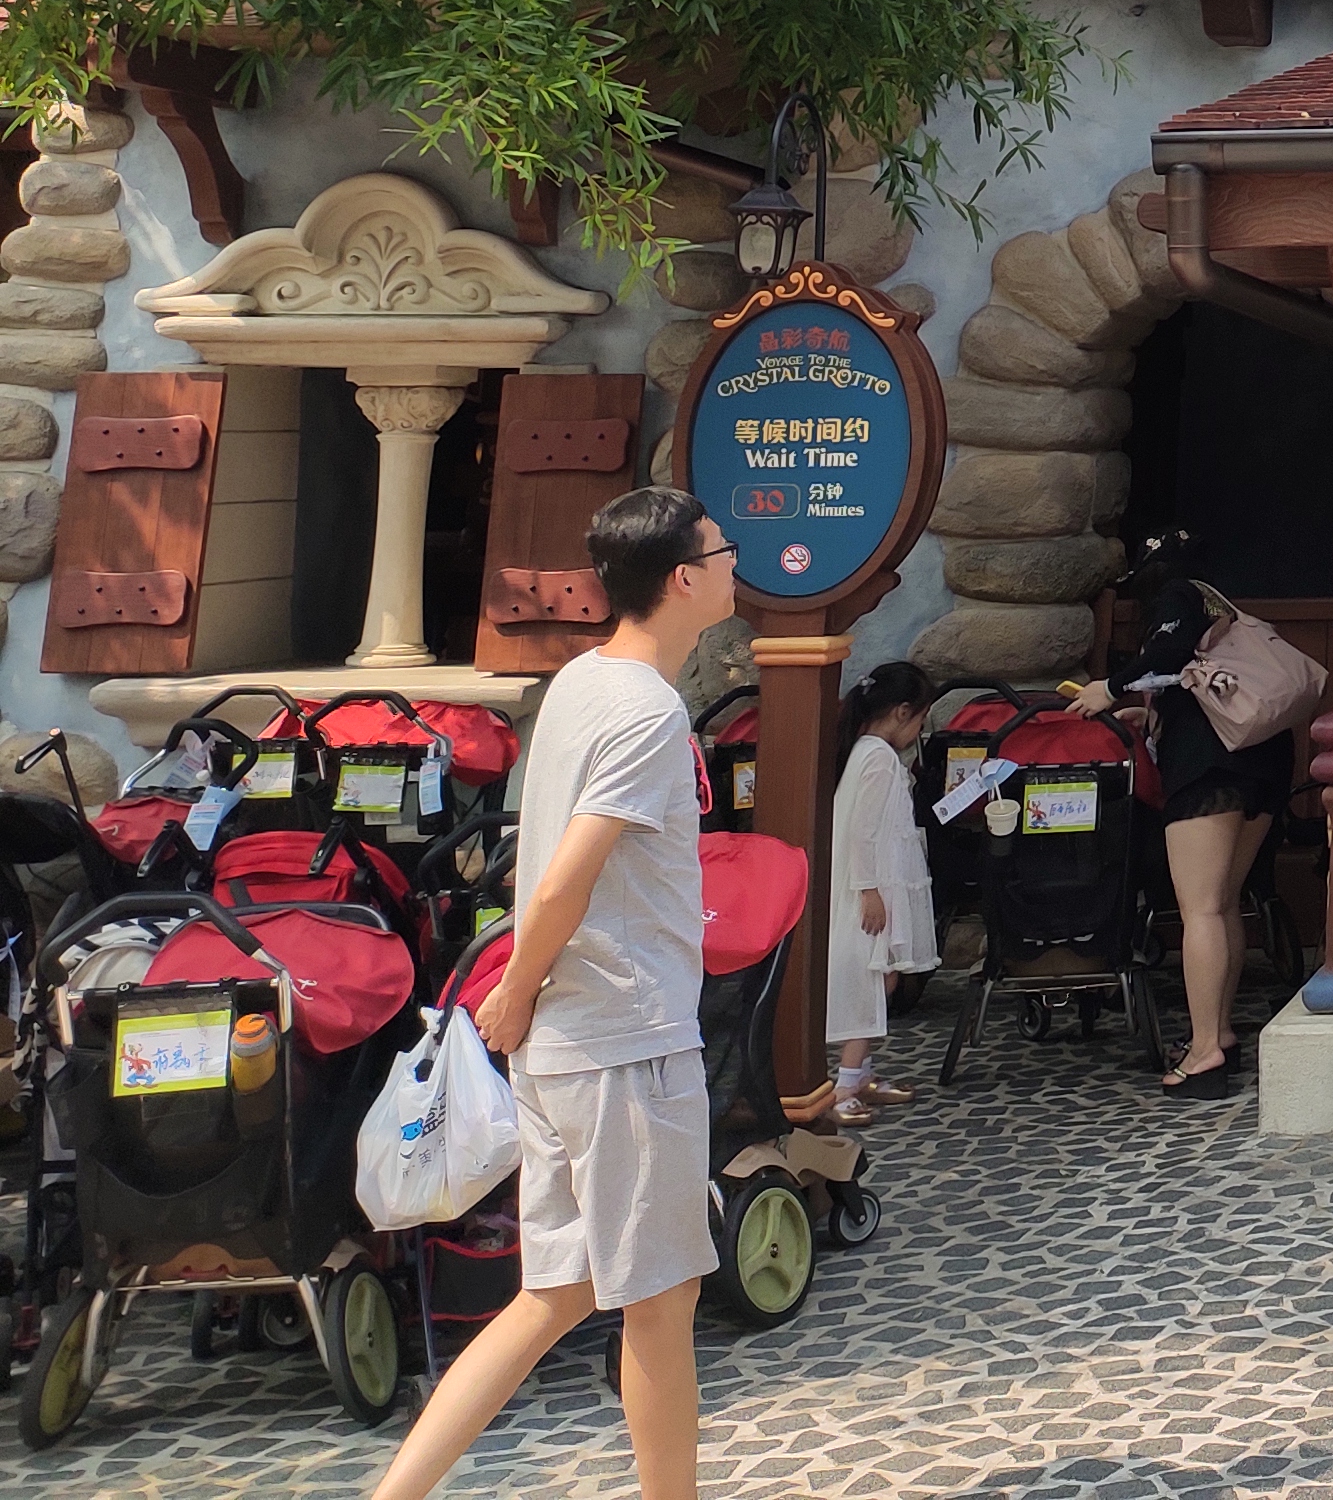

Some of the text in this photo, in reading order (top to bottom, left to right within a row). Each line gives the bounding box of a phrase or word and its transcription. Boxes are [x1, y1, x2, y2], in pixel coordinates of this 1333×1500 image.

[759, 327, 849, 351] 晶彩奇航
[756, 353, 851, 368] VOYAGE TO THE
[717, 365, 891, 397] CRYSTAL GROTTO
[734, 418, 870, 445] 等候时间约
[745, 448, 858, 469] Wait Time
[747, 490, 785, 513] 30
[808, 483, 843, 501] 分钟
[807, 503, 865, 518] Minutes
